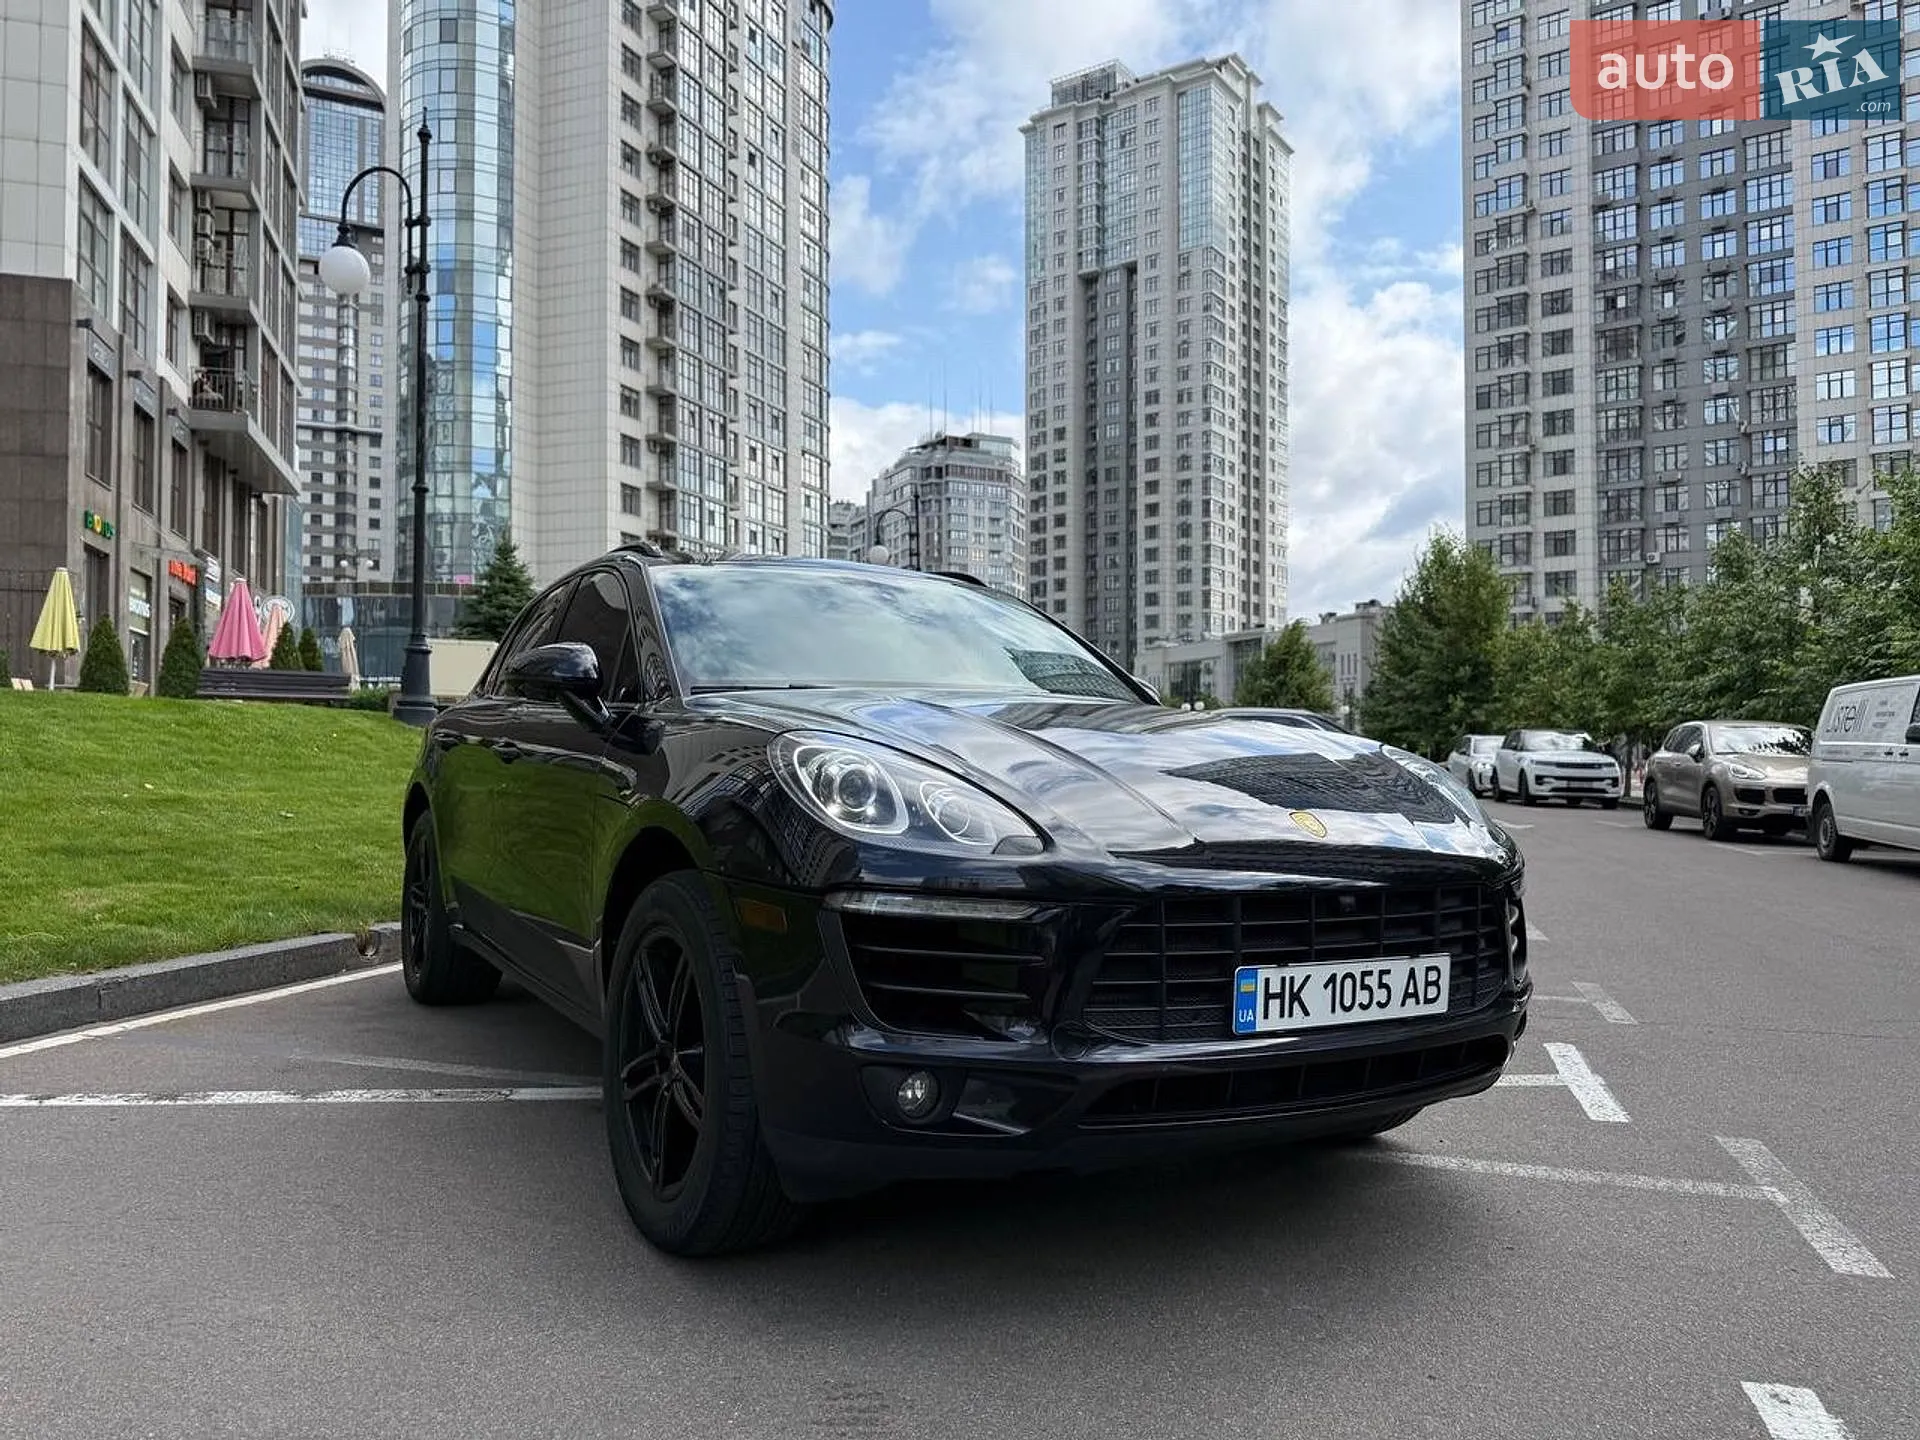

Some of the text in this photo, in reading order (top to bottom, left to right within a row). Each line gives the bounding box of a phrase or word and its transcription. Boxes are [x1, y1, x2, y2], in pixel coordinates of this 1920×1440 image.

[1262, 965, 1442, 1020] HK 1055 AB
[1238, 1009, 1255, 1023] UA
